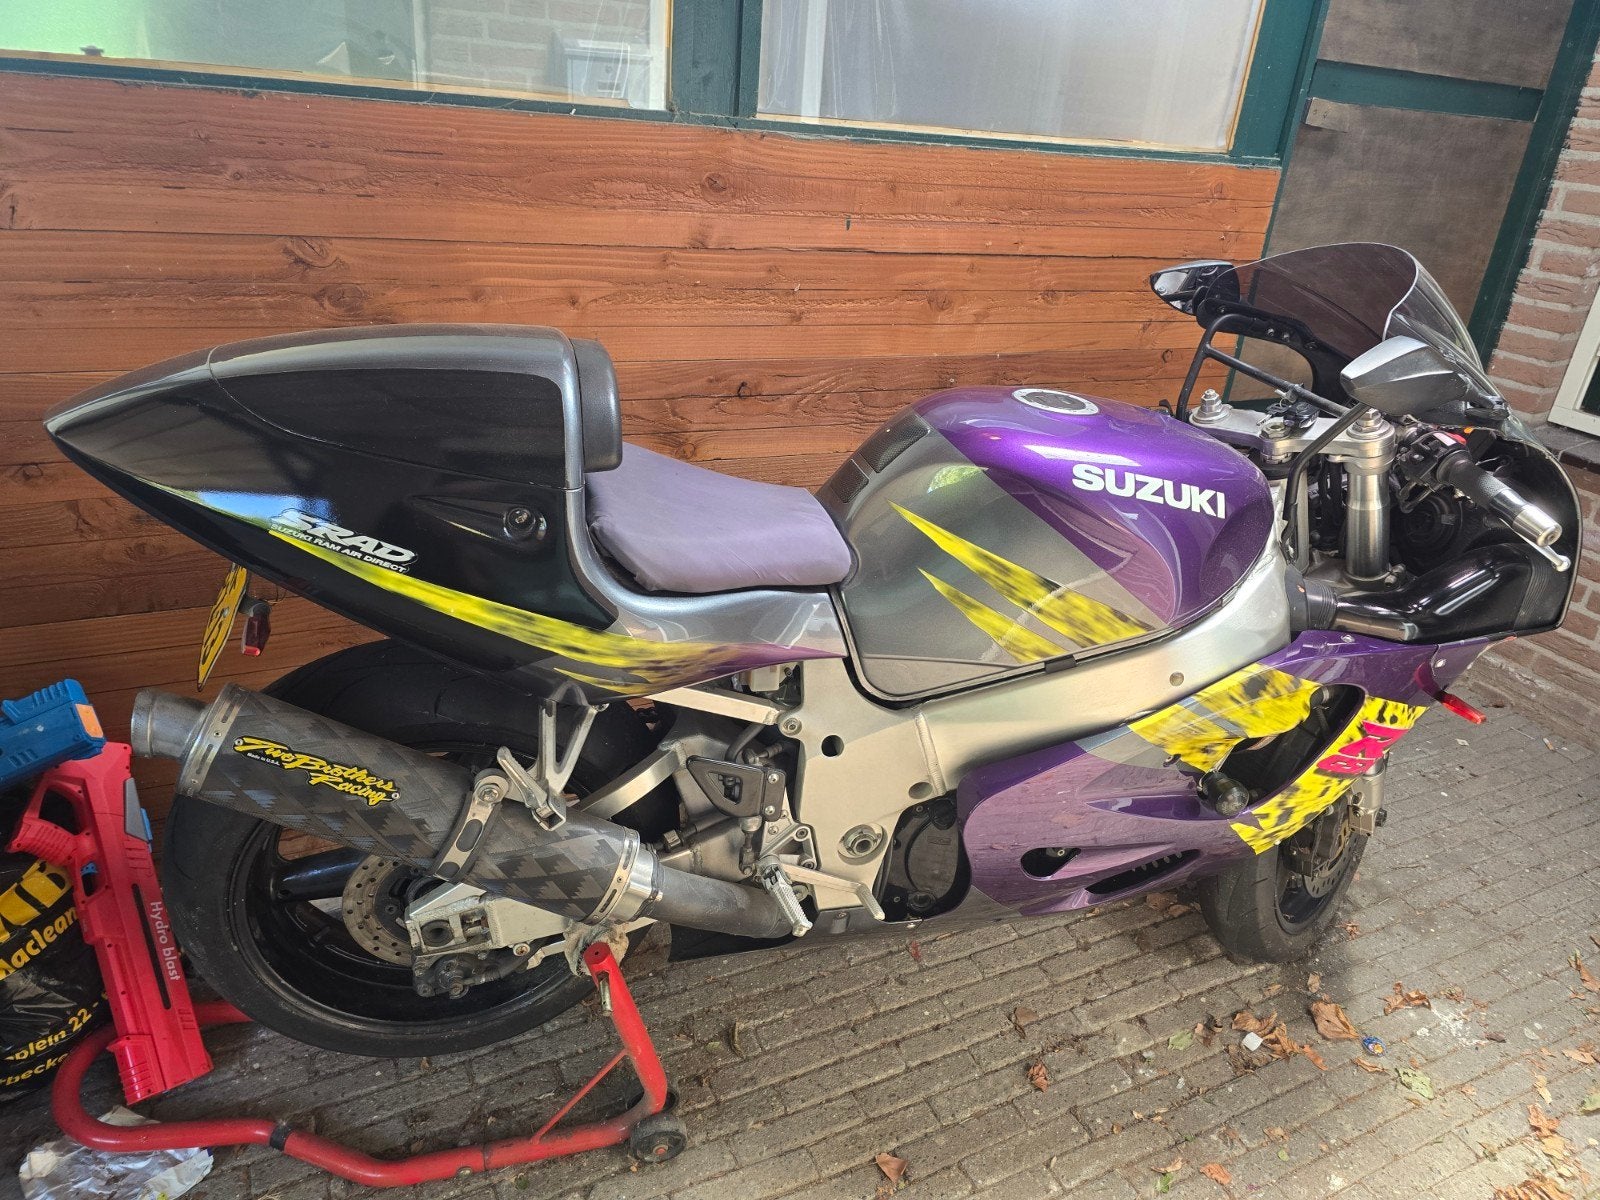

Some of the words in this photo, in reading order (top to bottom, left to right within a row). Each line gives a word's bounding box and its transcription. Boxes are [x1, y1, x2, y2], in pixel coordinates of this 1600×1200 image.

[1072, 464, 1225, 519] SUZUKI
[271, 510, 416, 562] SRAD
[271, 524, 314, 542] SUZUKI
[314, 539, 340, 552] RAM
[341, 548, 362, 559] AIR
[364, 554, 407, 573] DIRECT
[234, 737, 295, 762] Two
[282, 753, 397, 792] Brothers
[309, 772, 392, 806] Racing
[150, 901, 168, 944] Hydro
[162, 947, 180, 980] blast
[68, 1008, 92, 1032] 22
